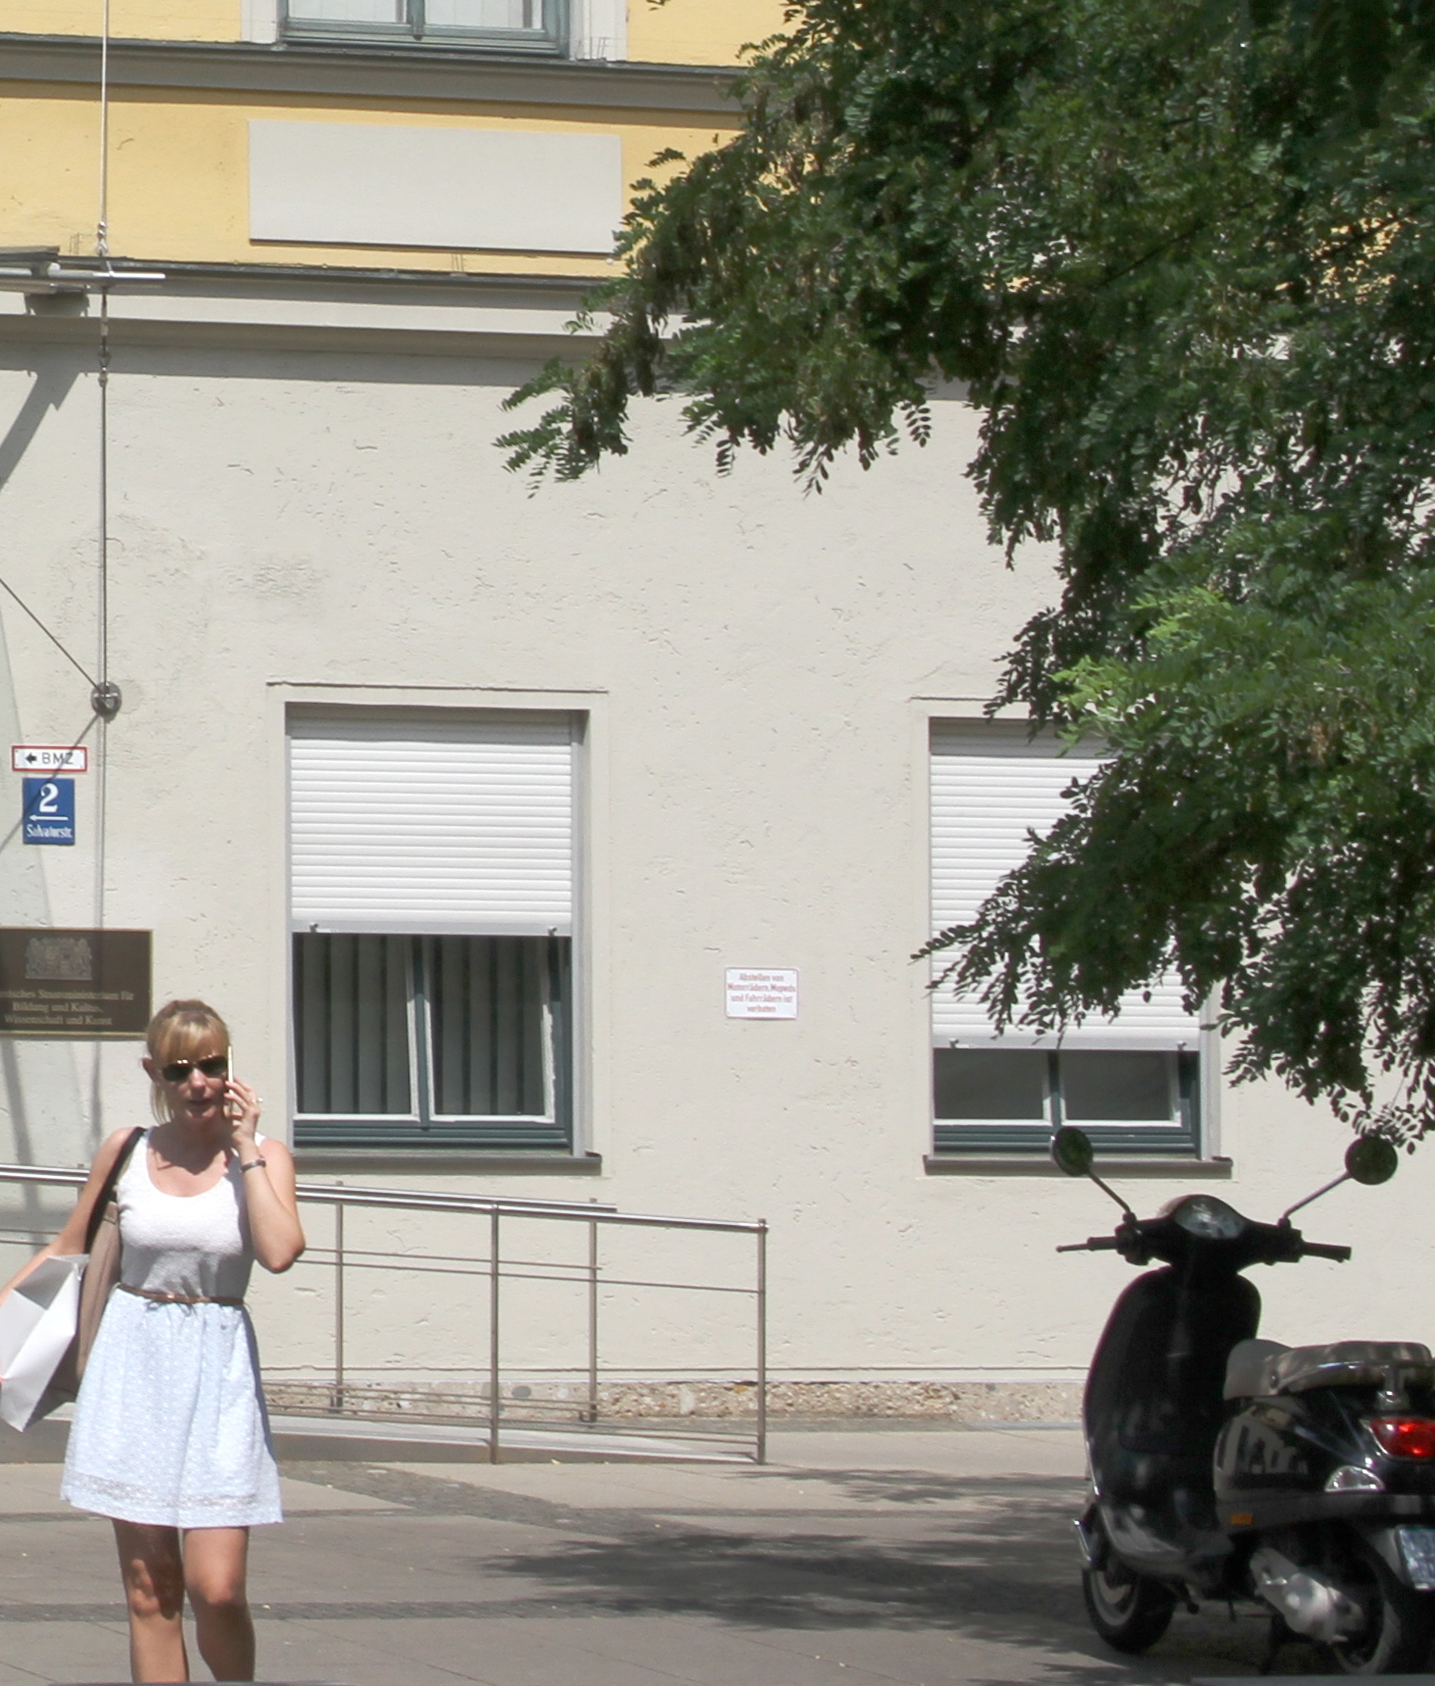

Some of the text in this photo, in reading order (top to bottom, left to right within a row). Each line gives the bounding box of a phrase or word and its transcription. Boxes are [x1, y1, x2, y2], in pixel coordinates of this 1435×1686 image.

[42, 752, 74, 765] BMZ
[39, 783, 59, 813] 2
[121, 989, 135, 1001] für
[731, 993, 744, 1002] und
[783, 995, 793, 1003] ist
[12, 1001, 49, 1014] Bildung
[51, 1002, 69, 1012] und
[4, 1014, 113, 1026] Wissenschaft und Kunst
